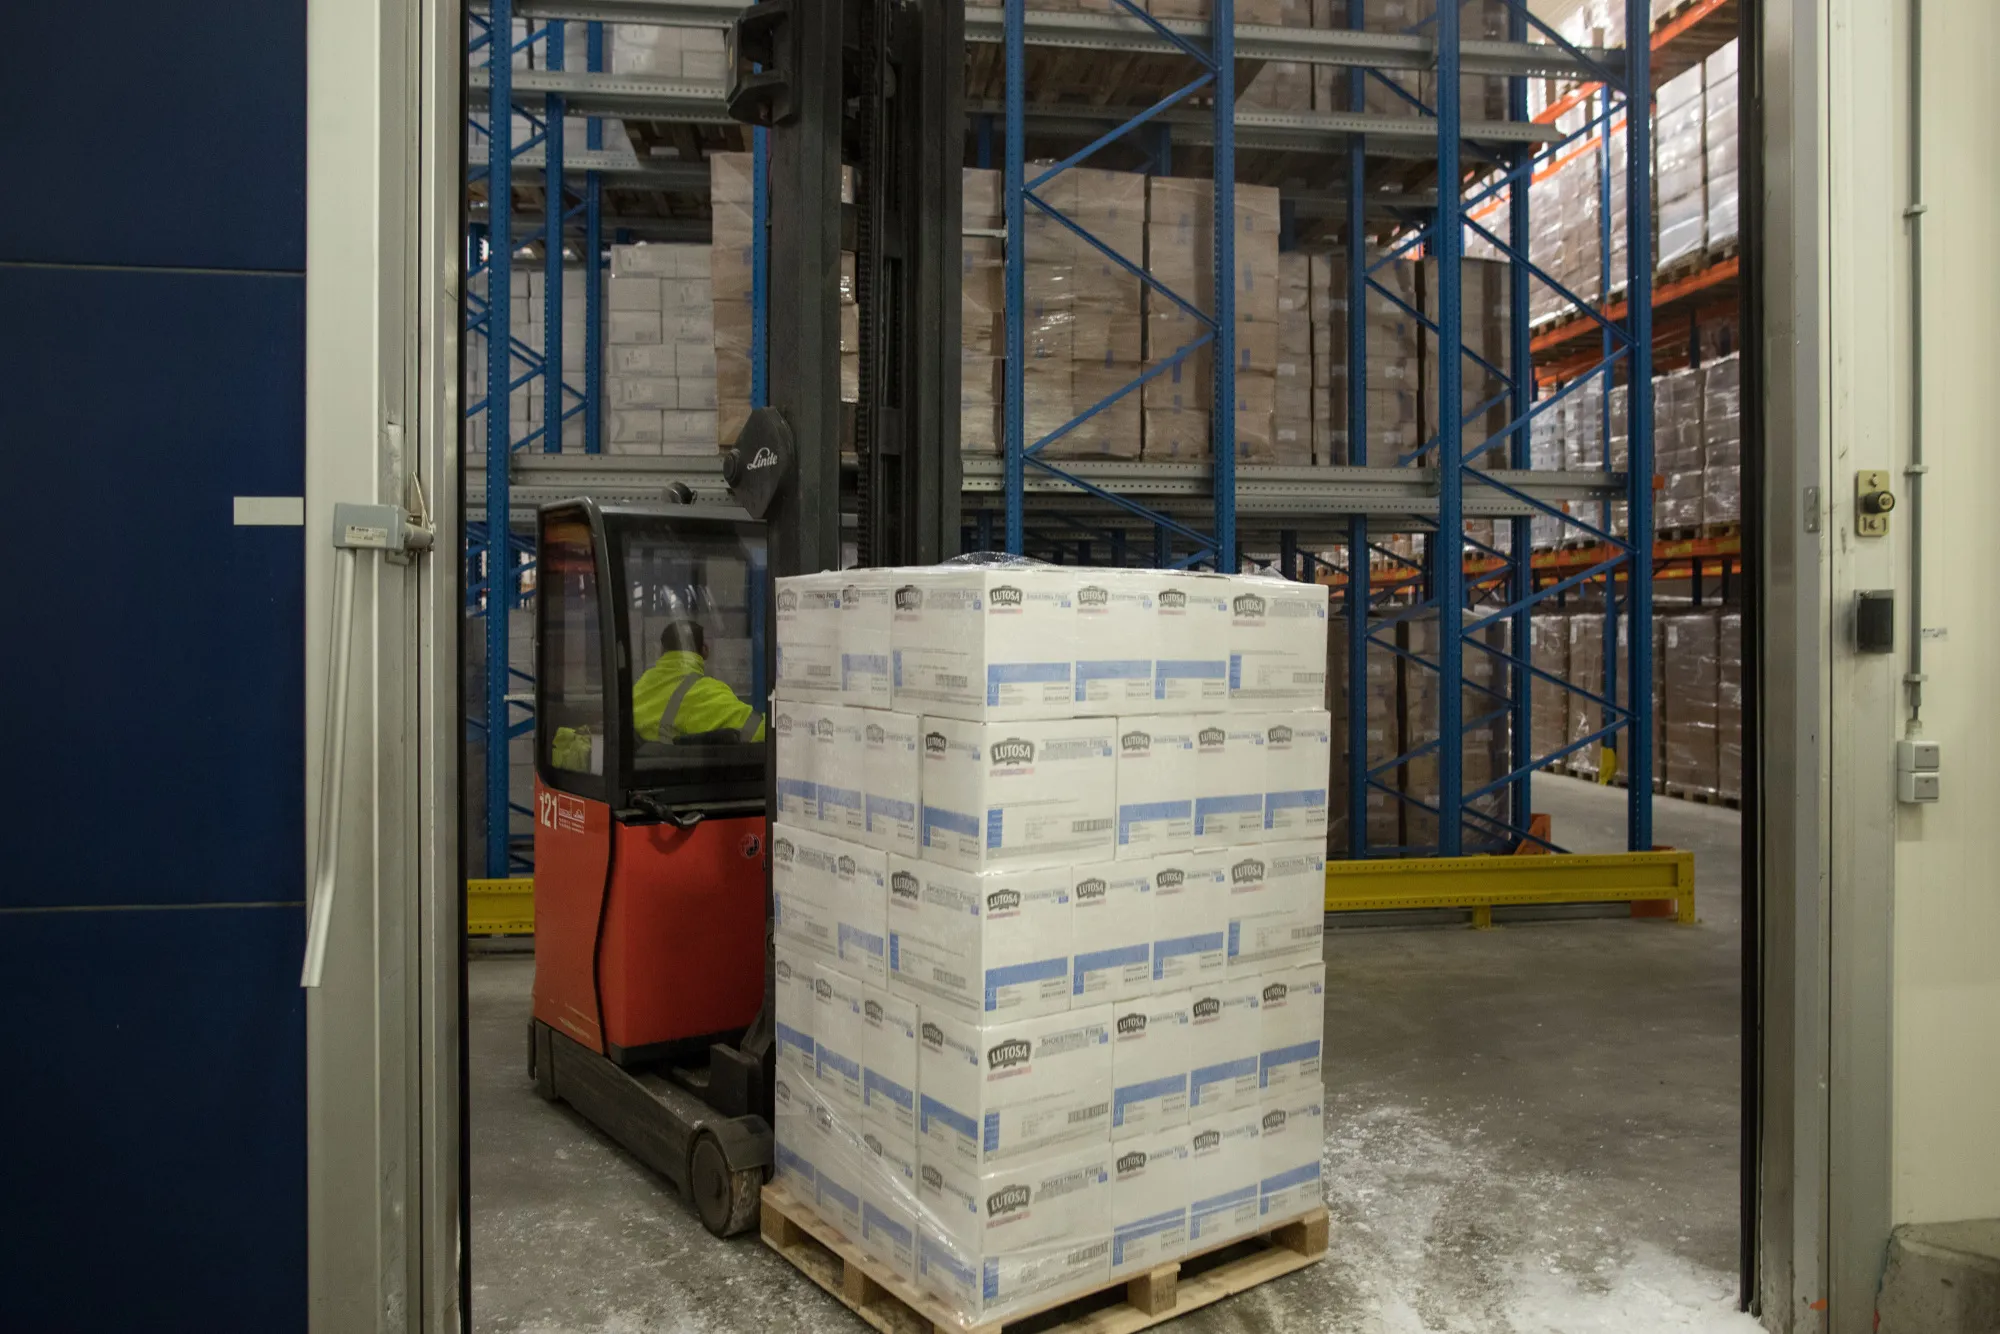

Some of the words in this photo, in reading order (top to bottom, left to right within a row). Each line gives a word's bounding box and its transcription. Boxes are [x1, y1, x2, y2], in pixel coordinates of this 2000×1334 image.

[746, 447, 778, 471] Linde
[991, 590, 1021, 603] LUTOSA
[1079, 590, 1107, 602] LUTOSA
[1160, 593, 1185, 605] LUTOSA
[1235, 598, 1264, 613] LUTOSA
[1123, 736, 1149, 748] LUTOSA
[1200, 732, 1225, 743] LUTOSA
[1268, 729, 1292, 741] LUTOSA
[994, 743, 1032, 761] LUTOSA
[539, 790, 557, 830] 121
[1233, 864, 1263, 879] LUTOSA
[893, 875, 918, 893] LUTOSA
[1158, 874, 1183, 886] LUTOSA
[1077, 882, 1105, 897] LUTOSA
[989, 893, 1019, 908] LUTOSA
[1264, 986, 1287, 1001] LUTOSA
[1195, 1002, 1220, 1017] LUTOSA
[1118, 1017, 1147, 1032] LUTOSA
[991, 1044, 1028, 1065] LUTOSA
[1263, 1113, 1286, 1129] LUTOSA
[1195, 1133, 1220, 1149] LUTOSA
[1118, 1154, 1146, 1171] LUTOSA
[991, 1189, 1027, 1212] LUTOSA
